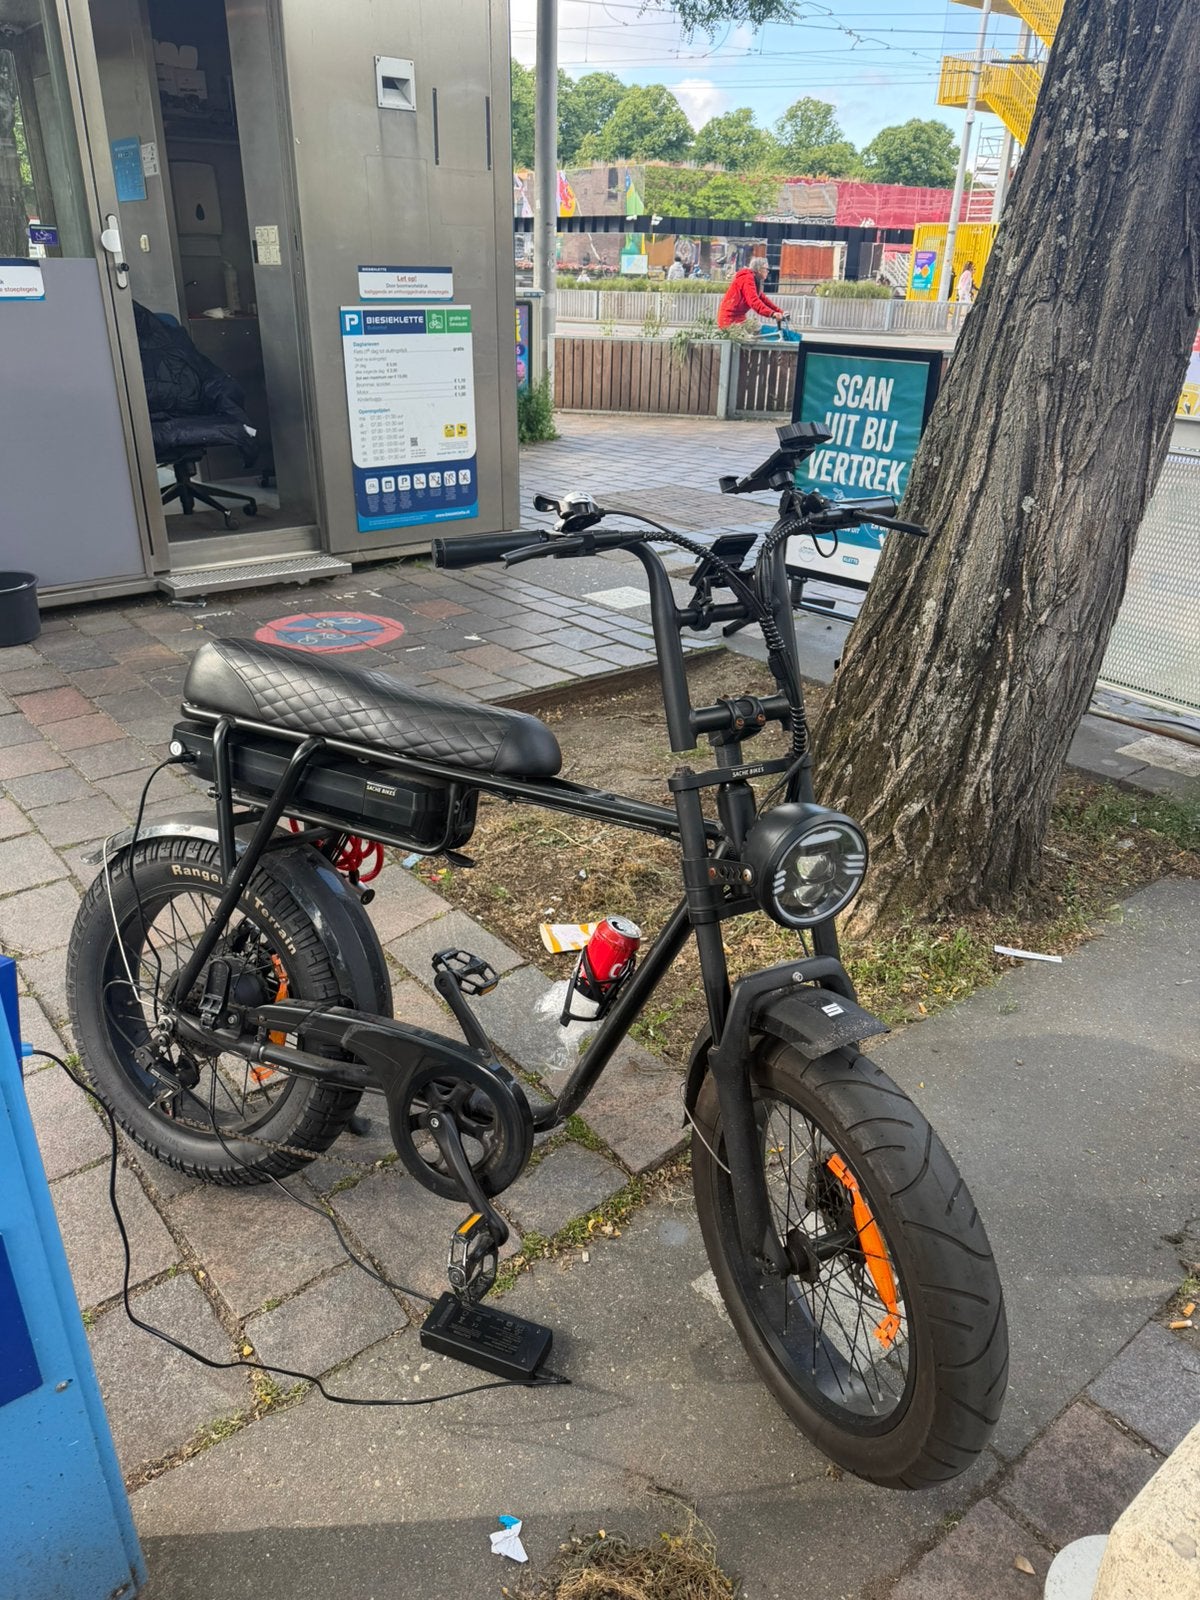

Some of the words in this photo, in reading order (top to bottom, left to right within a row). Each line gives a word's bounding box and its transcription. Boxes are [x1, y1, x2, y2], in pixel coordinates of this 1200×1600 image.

[344, 314, 358, 331] P
[366, 316, 424, 324] BIESIEKLETTE
[833, 373, 895, 412] SCAN
[824, 411, 860, 449] UIT
[862, 416, 898, 453] BIJ
[808, 448, 907, 496] VERTREK
[732, 769, 749, 778] SACHE
[749, 766, 764, 775] BIKES
[366, 784, 382, 794] SACHE
[382, 788, 396, 796] BIKES
[254, 899, 297, 956] Terrain
